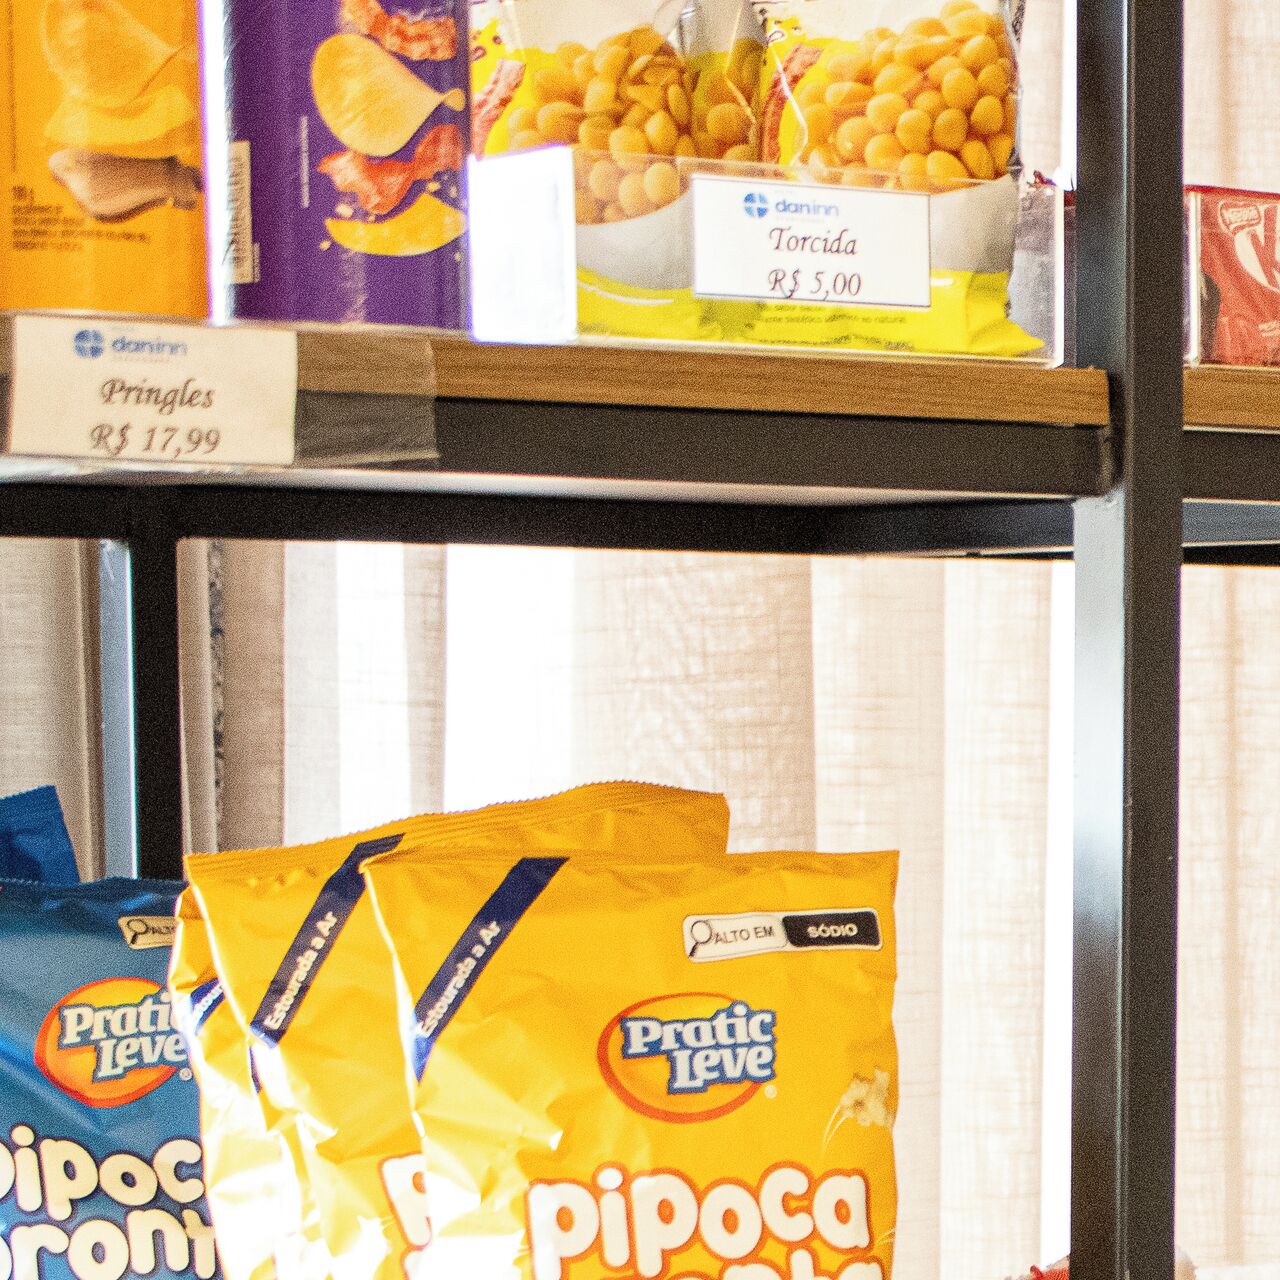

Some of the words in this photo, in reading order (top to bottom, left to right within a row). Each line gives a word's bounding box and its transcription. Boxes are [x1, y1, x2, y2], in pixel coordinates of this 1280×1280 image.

[775, 198, 840, 218] daninn
[769, 227, 858, 256] Torcida
[768, 268, 799, 299] R$
[809, 272, 862, 301] 5,00
[111, 334, 188, 361] daninn
[100, 377, 215, 416] Pringles
[90, 424, 130, 459] R$
[142, 422, 220, 456] 17,99
[316, 910, 338, 937] Ar
[471, 943, 487, 959] a
[479, 920, 501, 946] Ar
[713, 929, 750, 945] ALTO
[754, 925, 775, 938] EM
[807, 923, 859, 938] SÓDIO
[310, 936, 326, 950] a
[264, 948, 319, 1031] Estourada
[622, 1003, 773, 1057] Pratic
[95, 1033, 188, 1079] Leve
[672, 1044, 773, 1090] Leve
